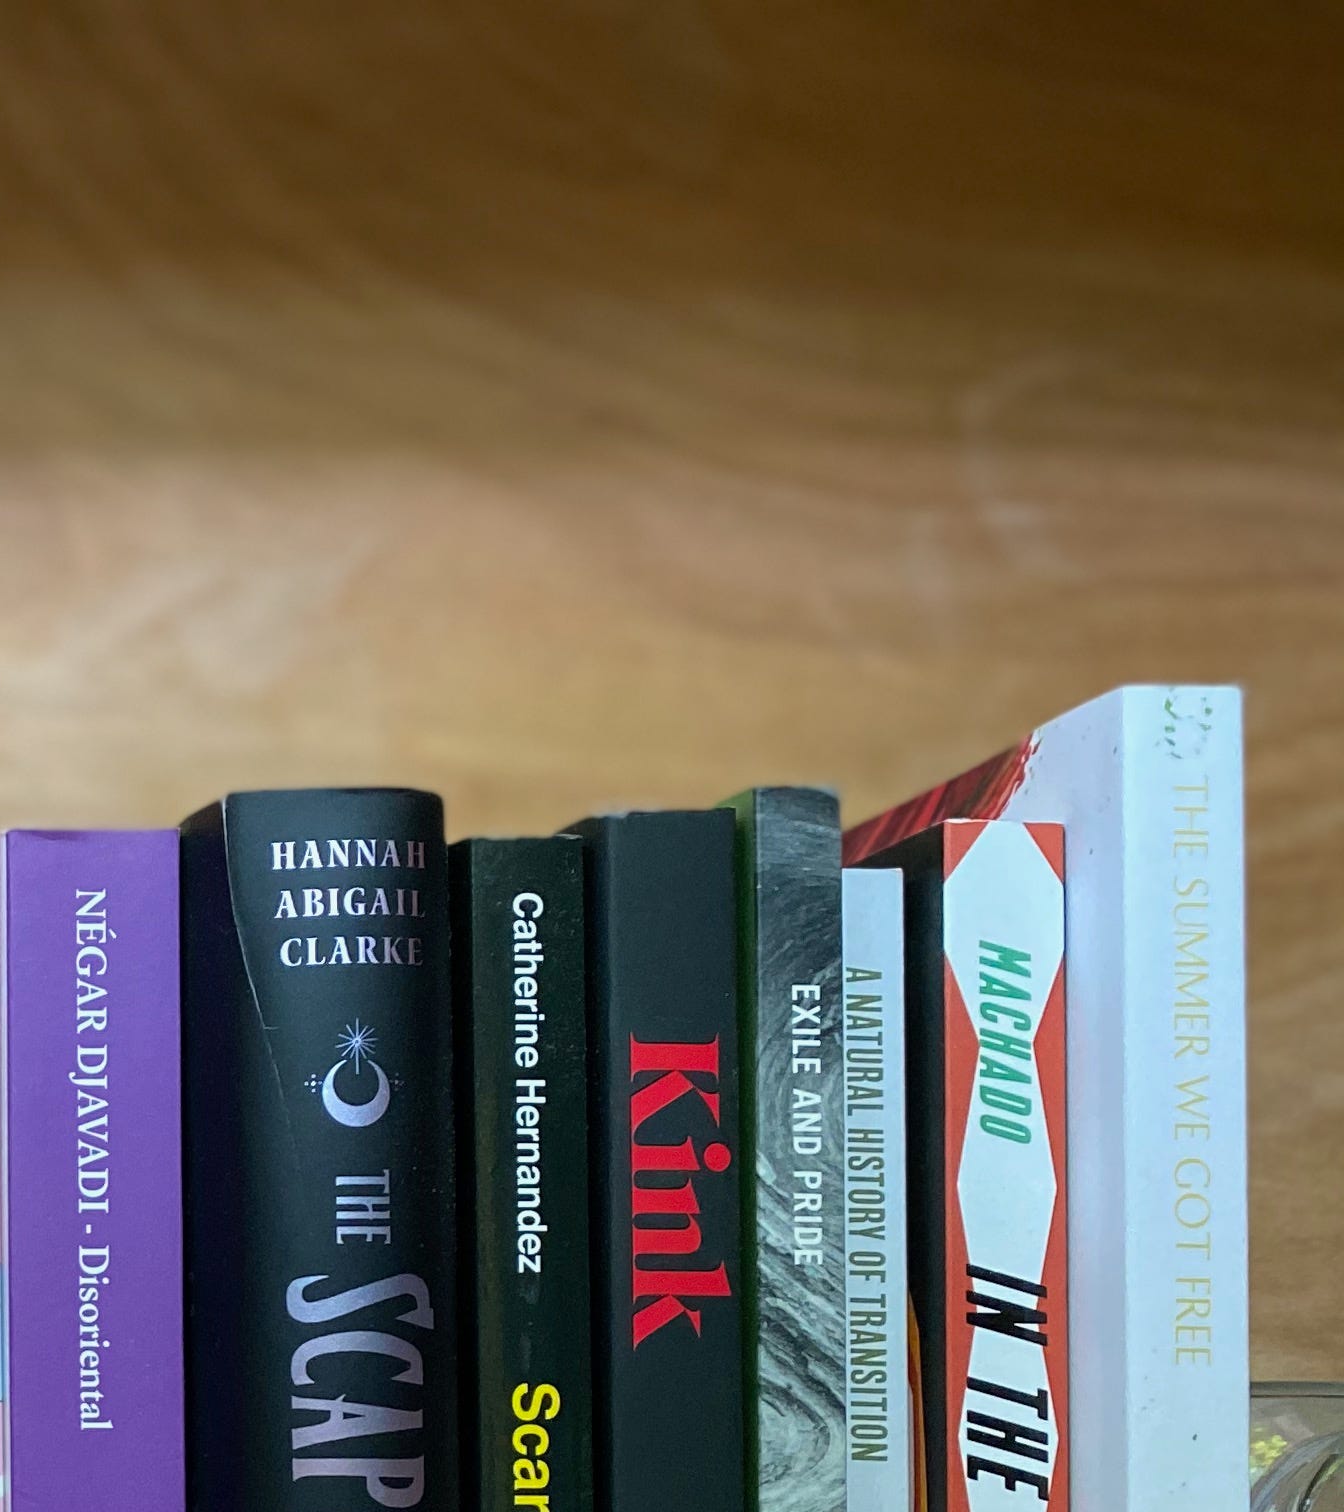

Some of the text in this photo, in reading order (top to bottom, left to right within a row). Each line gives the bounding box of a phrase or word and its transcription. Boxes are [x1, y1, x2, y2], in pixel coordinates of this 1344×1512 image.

[271, 840, 426, 871] HANNAH
[273, 888, 426, 919] ABIGAIL
[279, 936, 423, 967] CLARKE
[512, 893, 548, 1274] Catherine Hernandez
[791, 984, 823, 1266] EXILE AND PRIDE
[979, 939, 1031, 1145] MACHADO
[1172, 775, 1211, 1366] THE SUMMER WE GOT FREE
[69, 889, 116, 1431] NÉGAR DJAVADI Disoriental
[335, 1168, 391, 1246] THE
[630, 1032, 732, 1352] Kink
[845, 967, 888, 1462] A NATURAL HISTORY OF TRANSITION
[966, 1263, 1047, 1347] IN
[966, 1376, 1049, 1501] THE
